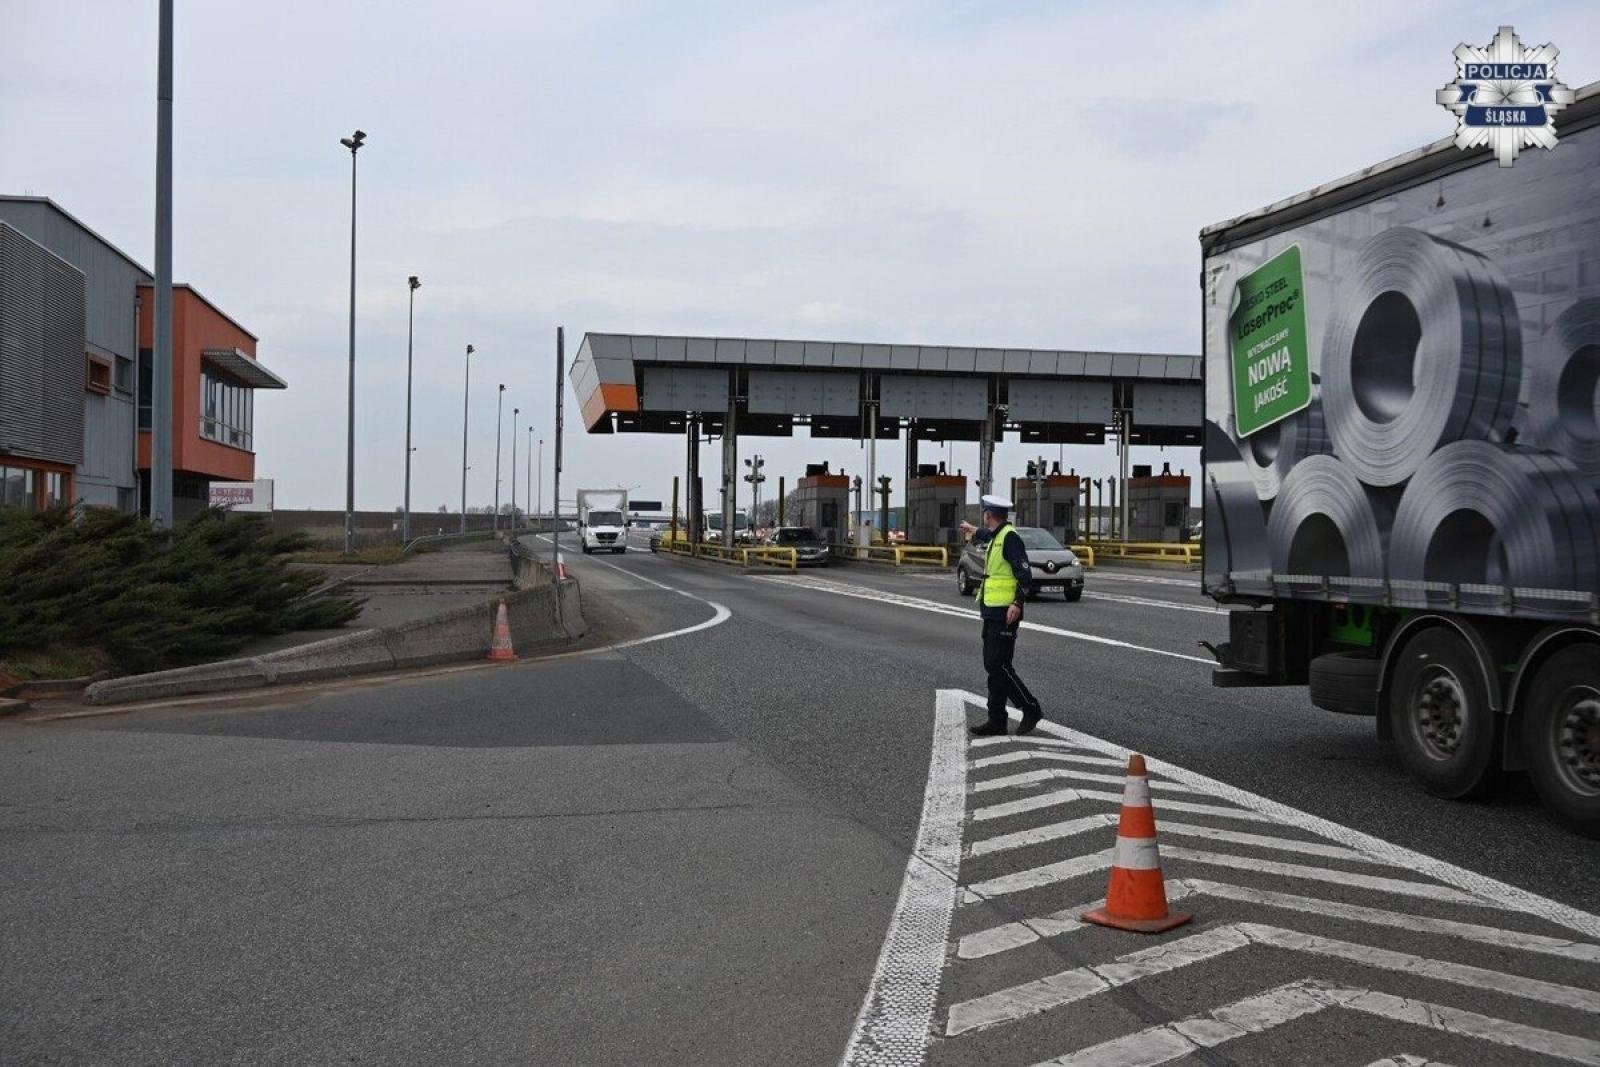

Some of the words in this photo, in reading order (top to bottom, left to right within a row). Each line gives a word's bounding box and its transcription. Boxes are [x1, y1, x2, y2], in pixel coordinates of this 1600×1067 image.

[1265, 277, 1289, 299] STEEL
[1248, 345, 1292, 388] NOWĄ
[1254, 376, 1290, 414] JAKOŚĆ
